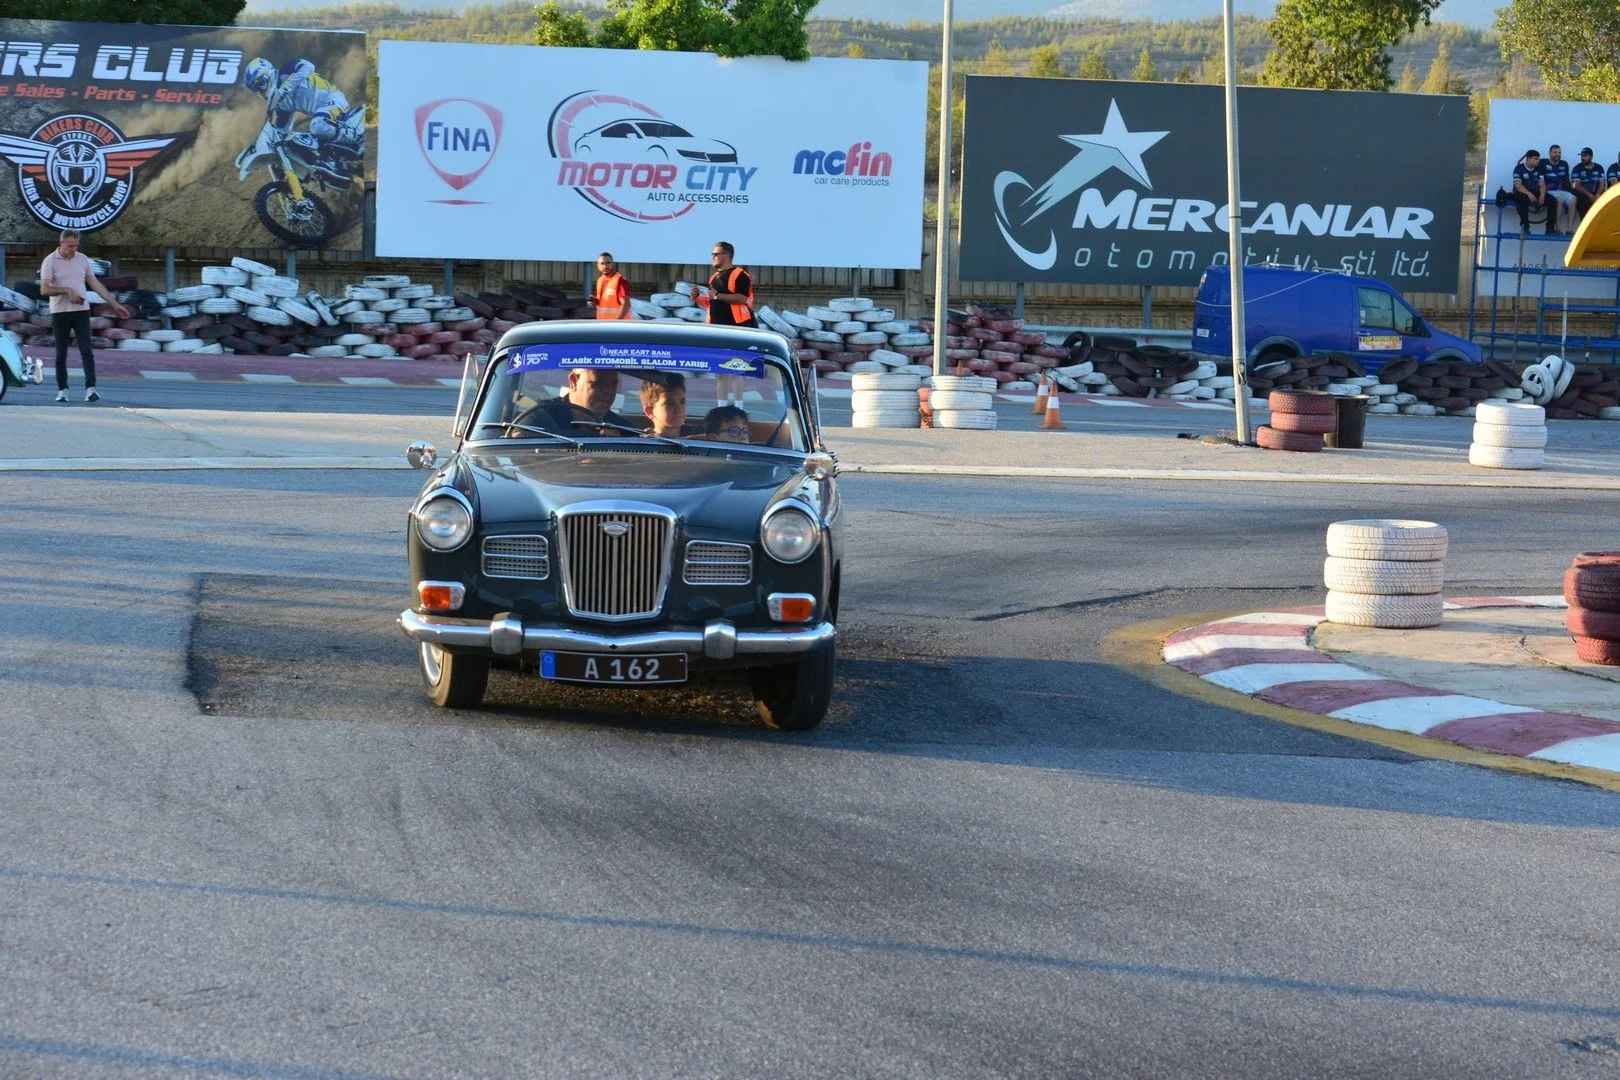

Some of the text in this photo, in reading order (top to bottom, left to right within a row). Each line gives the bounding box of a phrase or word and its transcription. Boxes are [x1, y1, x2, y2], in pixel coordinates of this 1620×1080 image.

[92, 45, 243, 84] CLUB
[14, 83, 66, 98] Sales
[83, 85, 137, 101] Parts
[154, 88, 223, 104] Service
[39, 117, 115, 144] BIKERS CLUB
[427, 121, 491, 152] FINA
[793, 141, 893, 177] mcfin
[557, 160, 759, 192] MOTOR CITY
[814, 177, 890, 187] car care products
[23, 177, 129, 228] HIGH END MOTORCYCLE SHOP
[647, 192, 749, 204] AUTO ACCESSORIES
[641, 359, 677, 367] SLALOM
[584, 657, 660, 680] A 162
